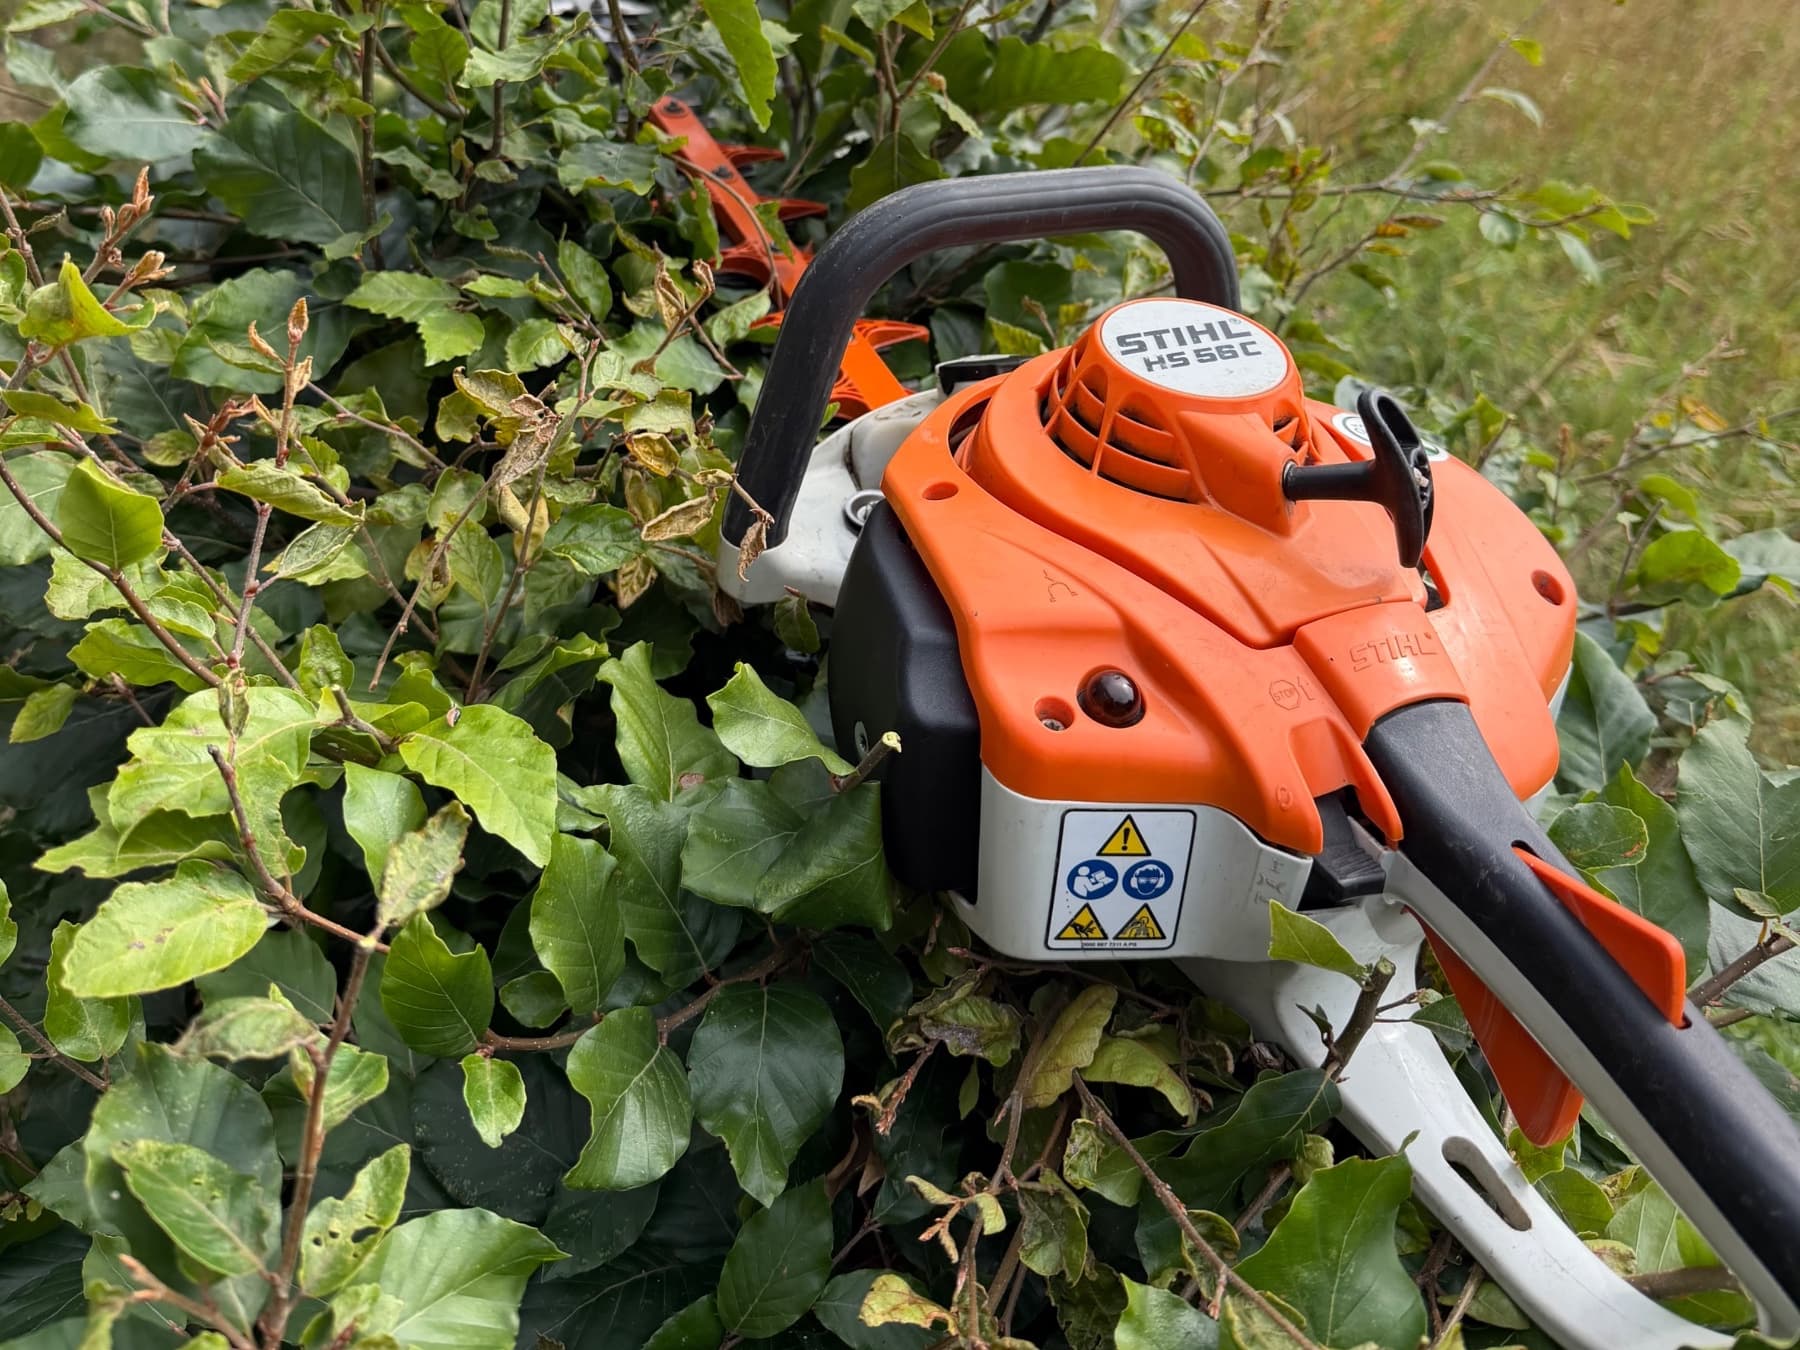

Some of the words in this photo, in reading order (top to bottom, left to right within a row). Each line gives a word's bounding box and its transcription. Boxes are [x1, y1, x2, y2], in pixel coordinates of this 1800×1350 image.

[1116, 319, 1252, 356] STIHL
[1143, 351, 1190, 372] HS
[1192, 344, 1240, 364] 56
[1241, 341, 1263, 357] C
[1349, 634, 1438, 673] STIHL
